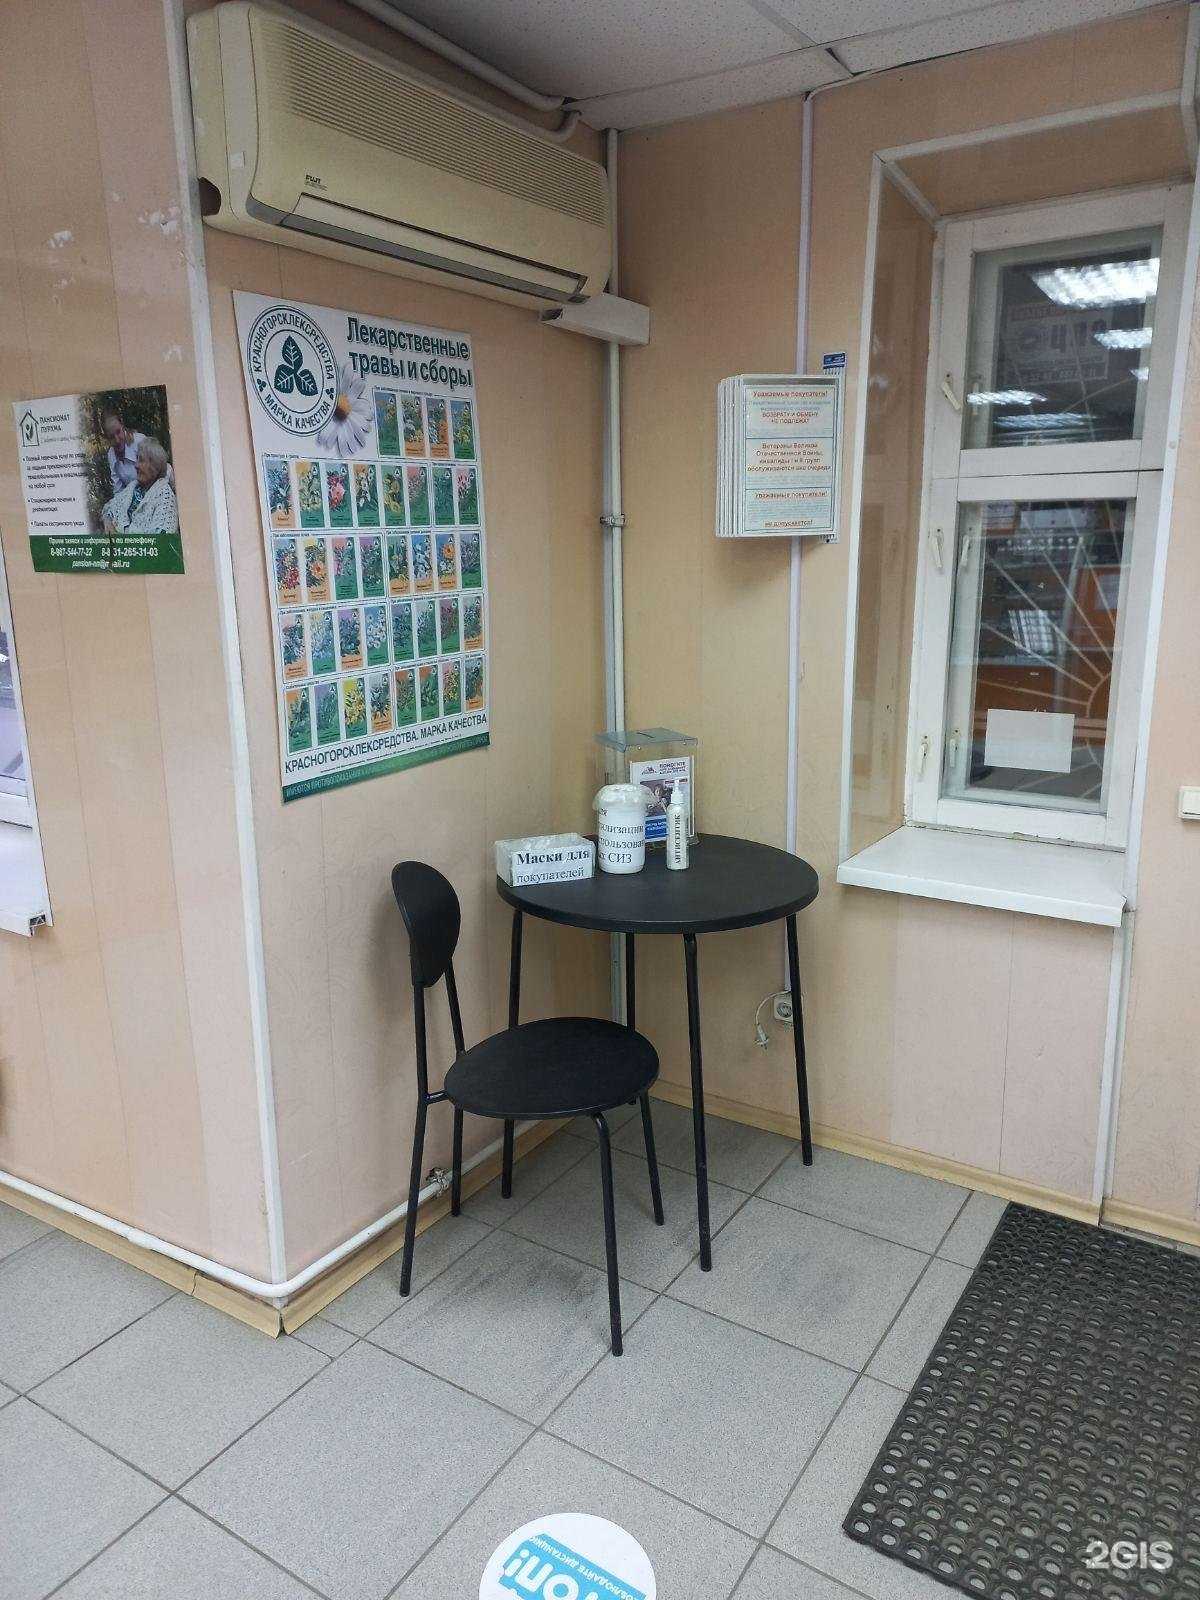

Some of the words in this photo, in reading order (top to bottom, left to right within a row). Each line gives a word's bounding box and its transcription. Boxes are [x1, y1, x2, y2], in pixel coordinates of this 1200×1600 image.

[252, 312, 335, 380] КРАСНОГОРСКЛЕКСРЕДСТВА
[347, 316, 471, 360] Лекарственные
[349, 351, 404, 381] травы
[407, 362, 418, 379] и
[420, 358, 474, 390] сборы
[264, 393, 293, 427] МАРКА
[295, 401, 331, 429] КАЧЕСТВА
[420, 722, 447, 740] МАРКА
[448, 713, 487, 732] КАЧЕСТВА
[517, 852, 563, 866] Маски
[565, 850, 590, 862] для
[517, 866, 585, 884] покупателей
[608, 852, 632, 864] СИЗ
[504, 1549, 602, 1600] ОП!
[577, 1562, 642, 1600] ОБЛЮДАЙТЕ
